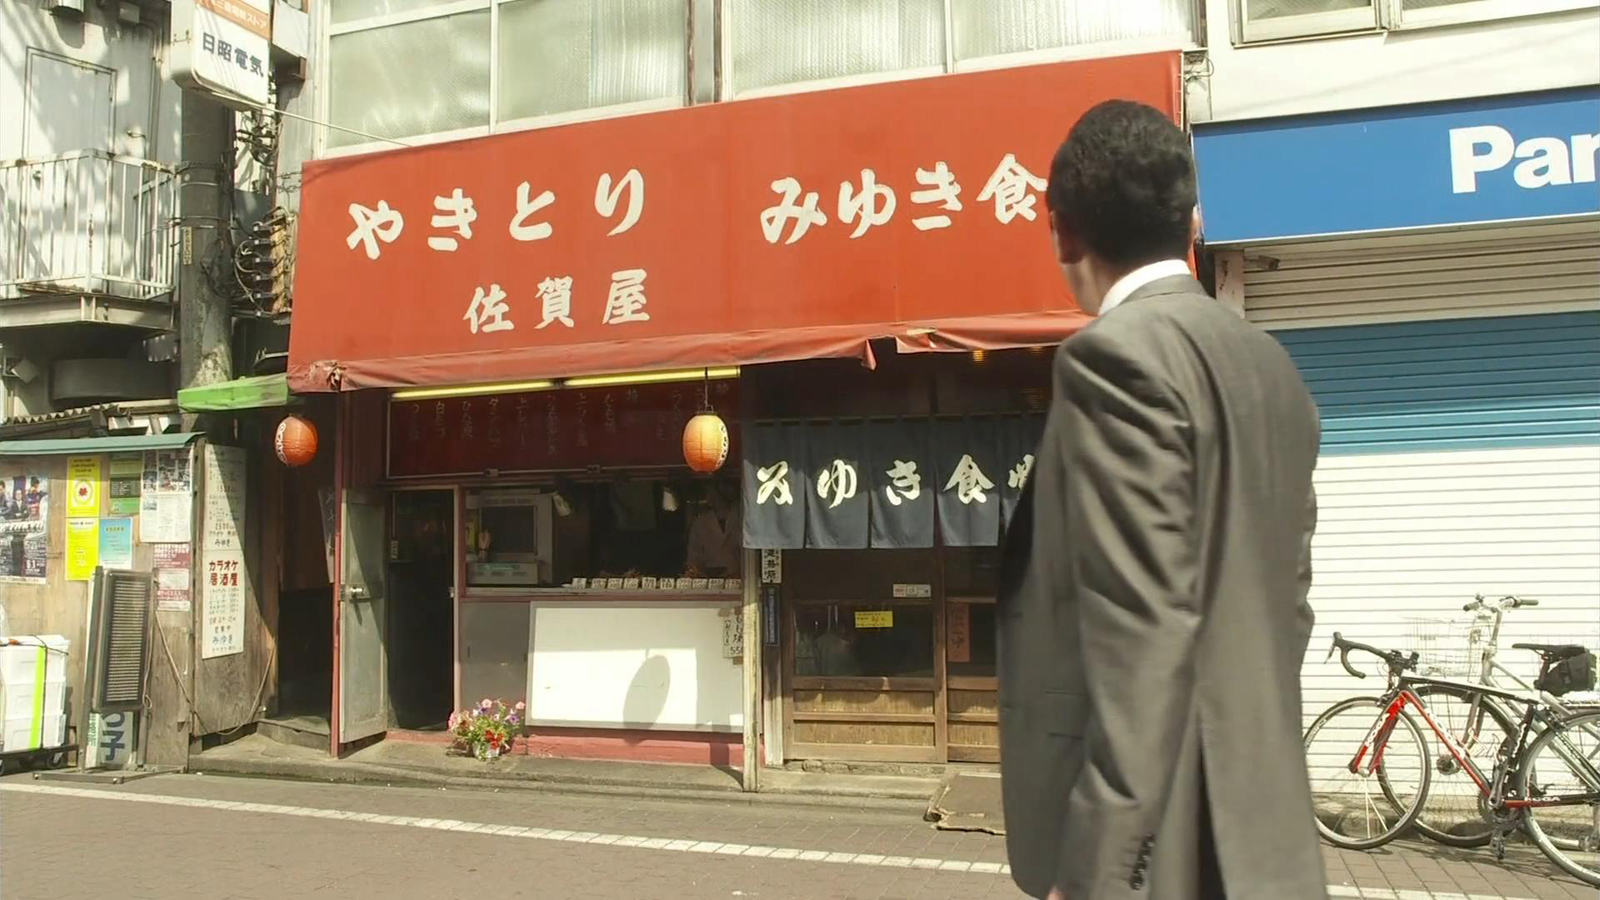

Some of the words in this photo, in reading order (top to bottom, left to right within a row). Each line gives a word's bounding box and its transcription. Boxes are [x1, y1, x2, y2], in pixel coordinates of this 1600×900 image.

[203, 32, 264, 78] 日昭電気
[346, 168, 644, 260] やきとり
[463, 268, 650, 334] 佐賀屋
[208, 560, 239, 572] カラオケ
[210, 572, 238, 587] 居酒屋
